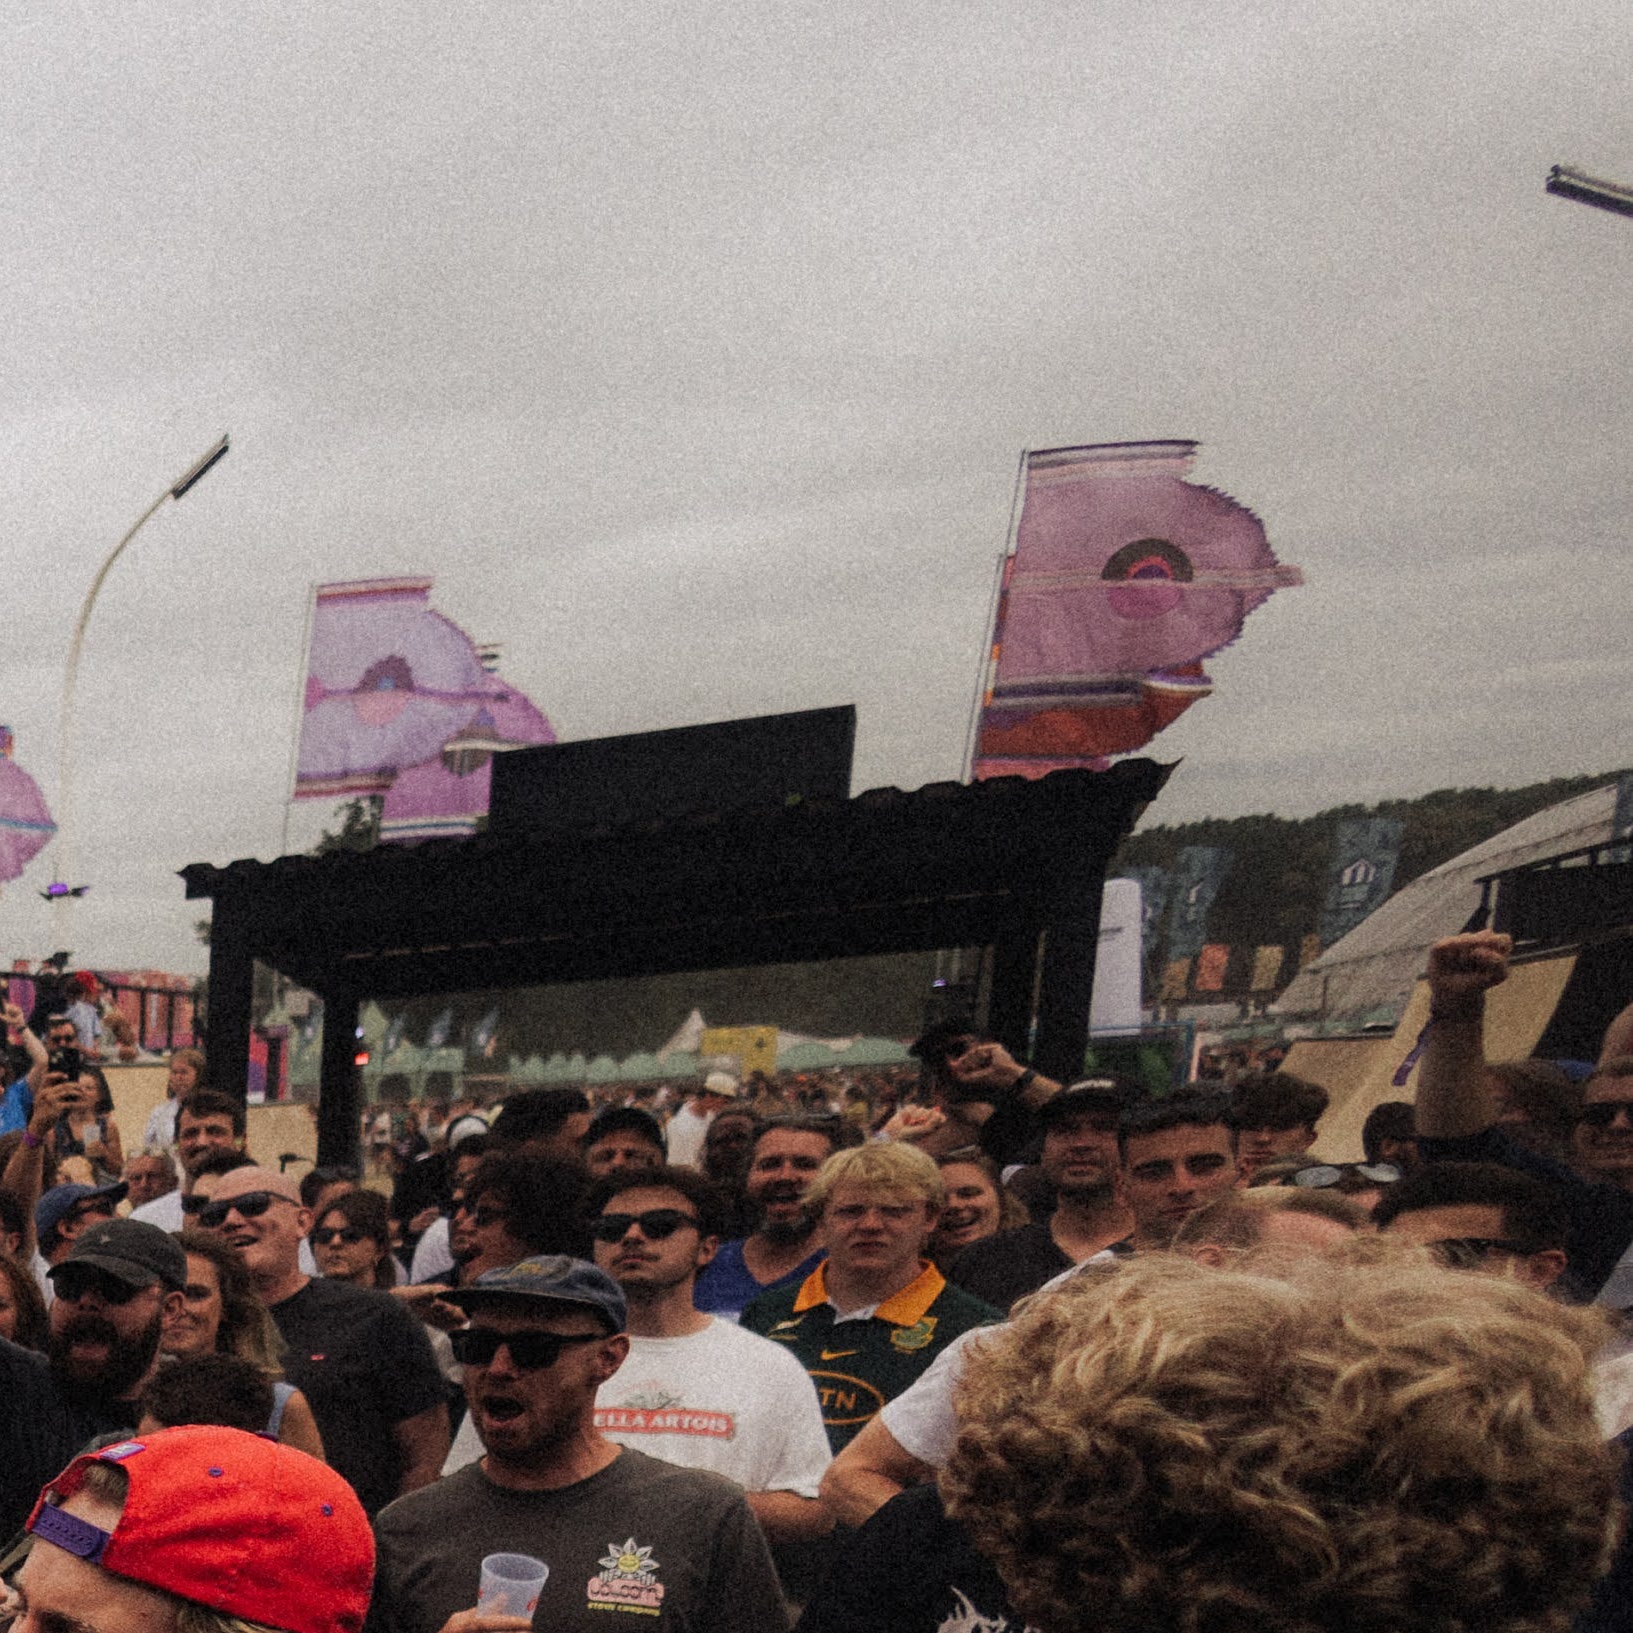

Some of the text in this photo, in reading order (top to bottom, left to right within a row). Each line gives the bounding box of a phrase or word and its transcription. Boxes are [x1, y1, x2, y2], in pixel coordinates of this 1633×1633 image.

[818, 1387, 856, 1411] TN
[593, 1412, 728, 1432] ELLA ARTOIS
